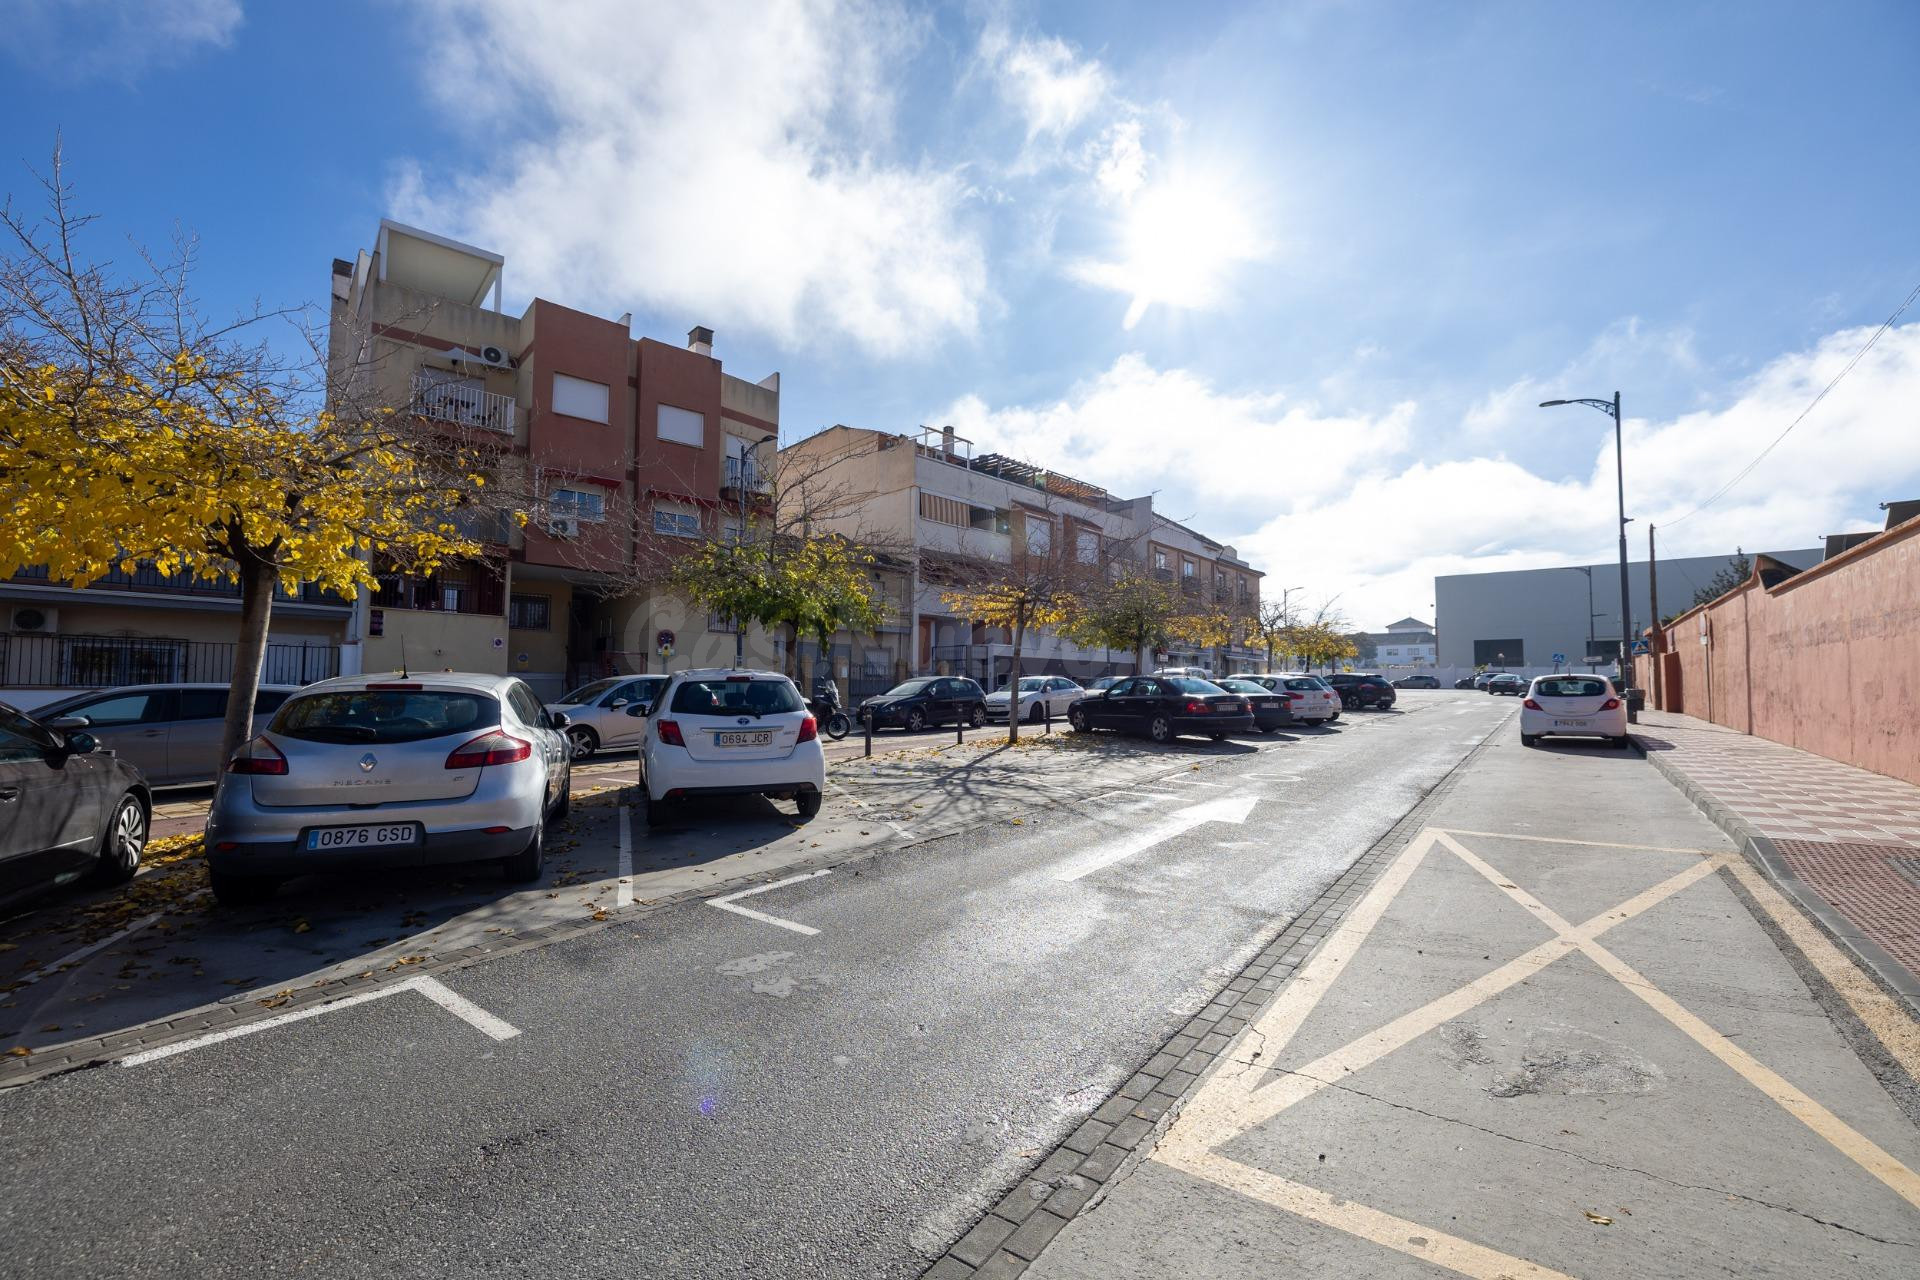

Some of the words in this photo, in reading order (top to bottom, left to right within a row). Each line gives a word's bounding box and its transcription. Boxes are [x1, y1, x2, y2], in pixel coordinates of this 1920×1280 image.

[722, 735, 747, 745] 0694
[751, 733, 769, 743] JCR
[321, 829, 369, 847] 0876
[377, 827, 412, 843] GSD
